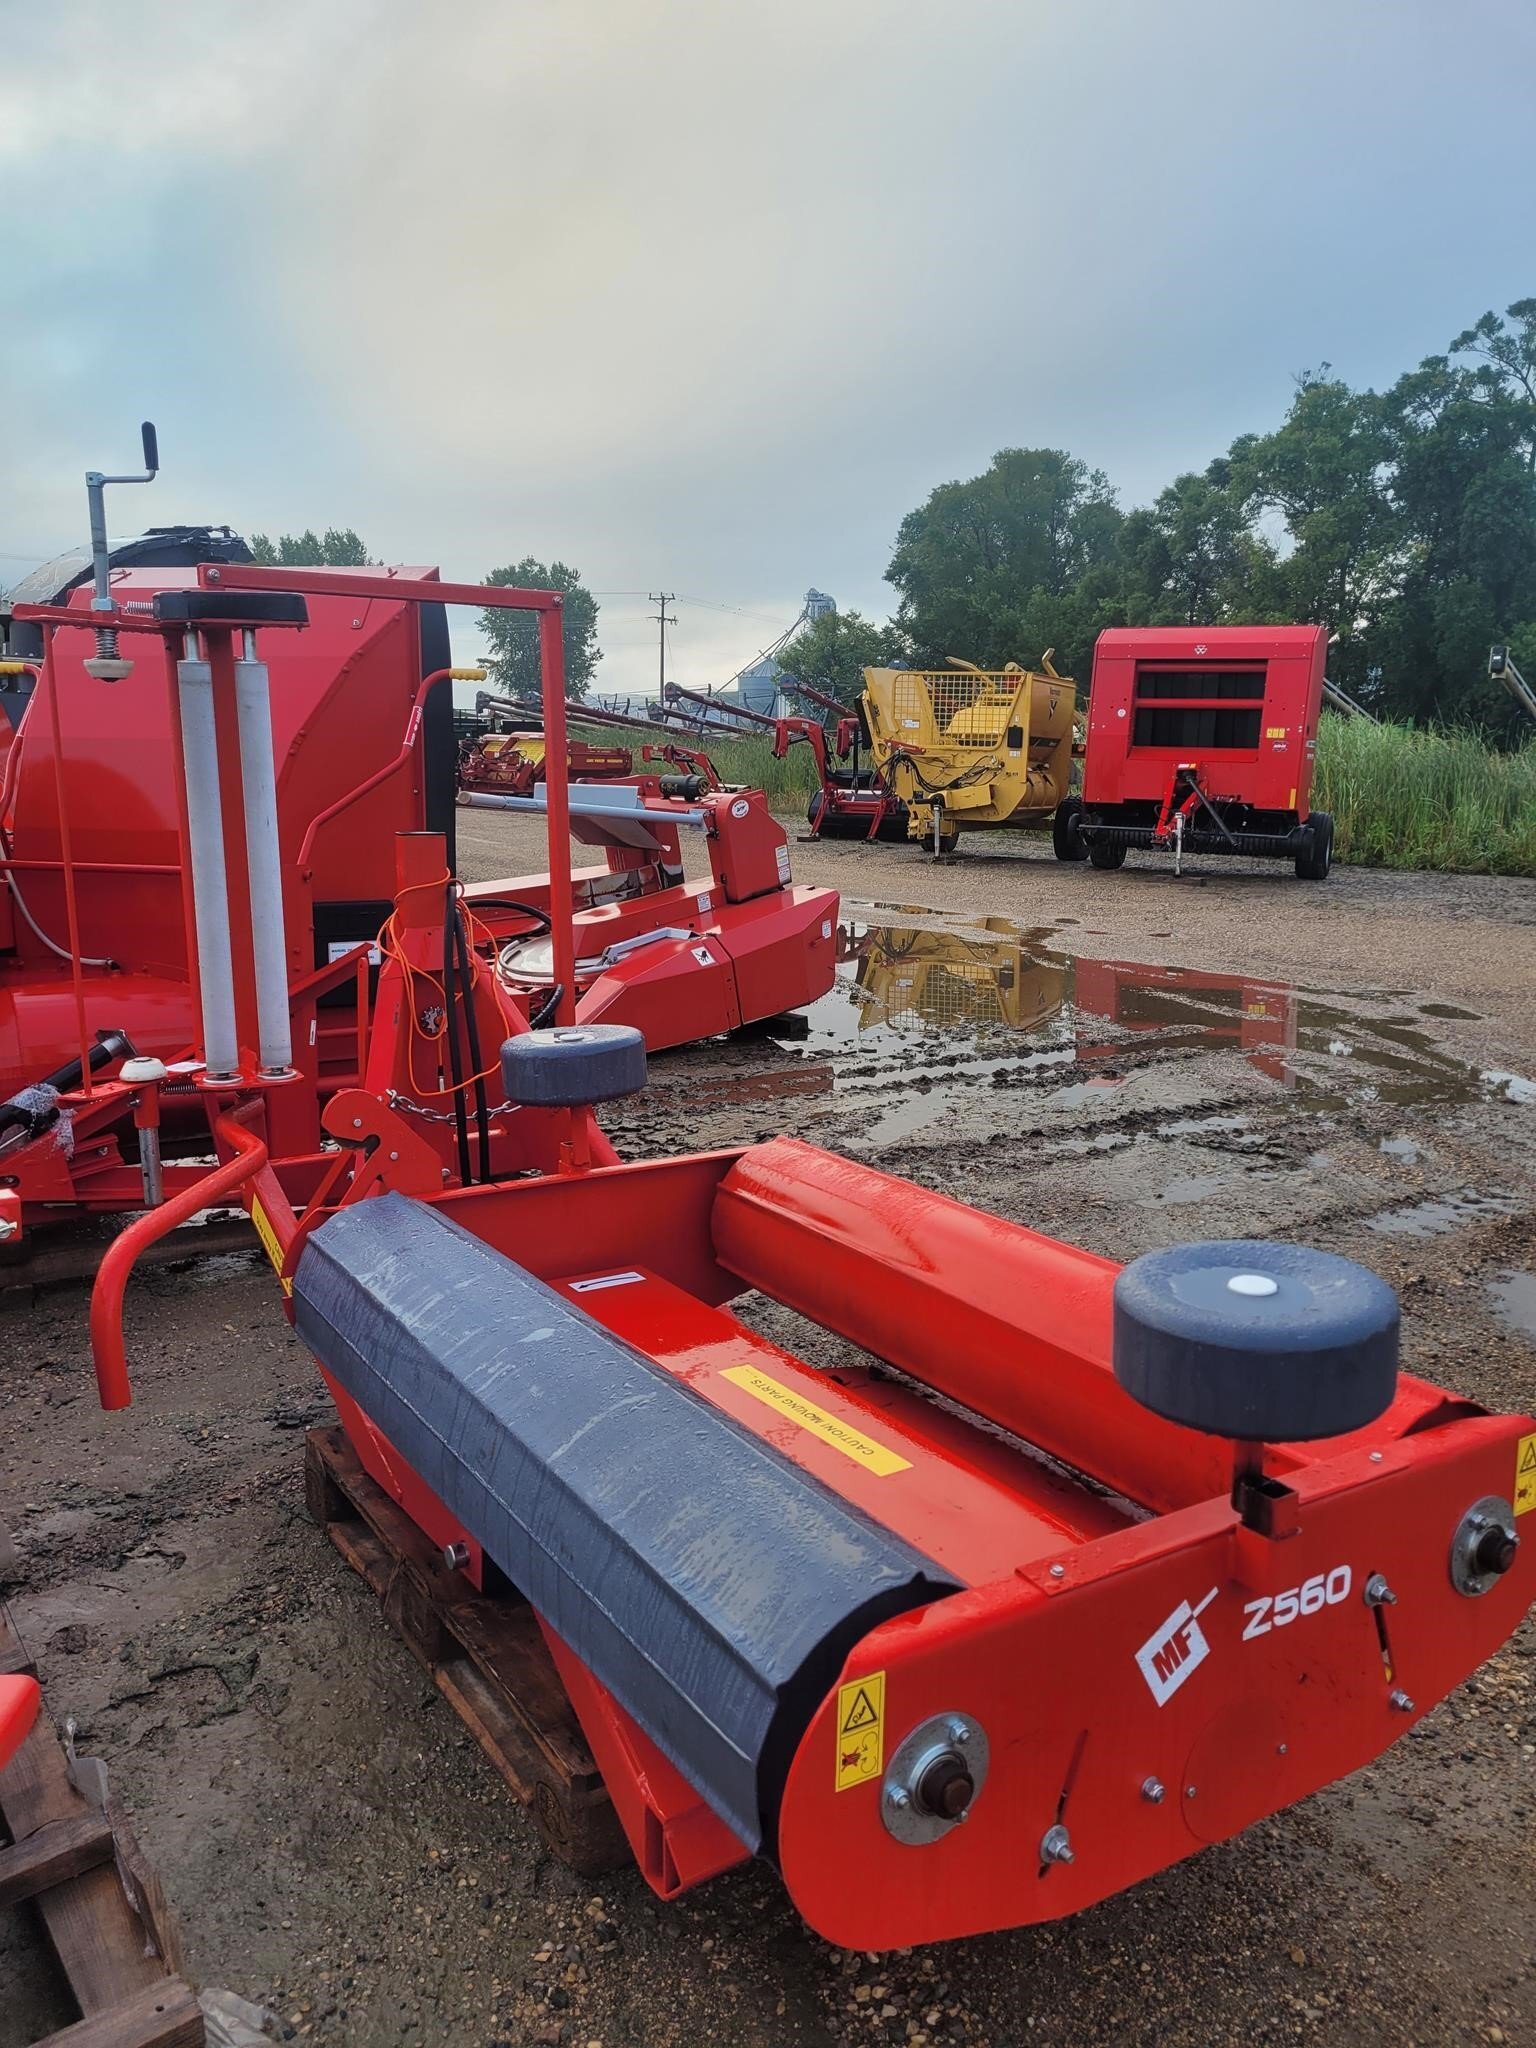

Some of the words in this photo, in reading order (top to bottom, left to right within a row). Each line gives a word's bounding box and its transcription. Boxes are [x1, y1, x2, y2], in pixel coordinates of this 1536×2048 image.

[782, 1398, 822, 1424] MOVING
[821, 1421, 875, 1456] CAUTION!
[1242, 1564, 1352, 1641] Z560
